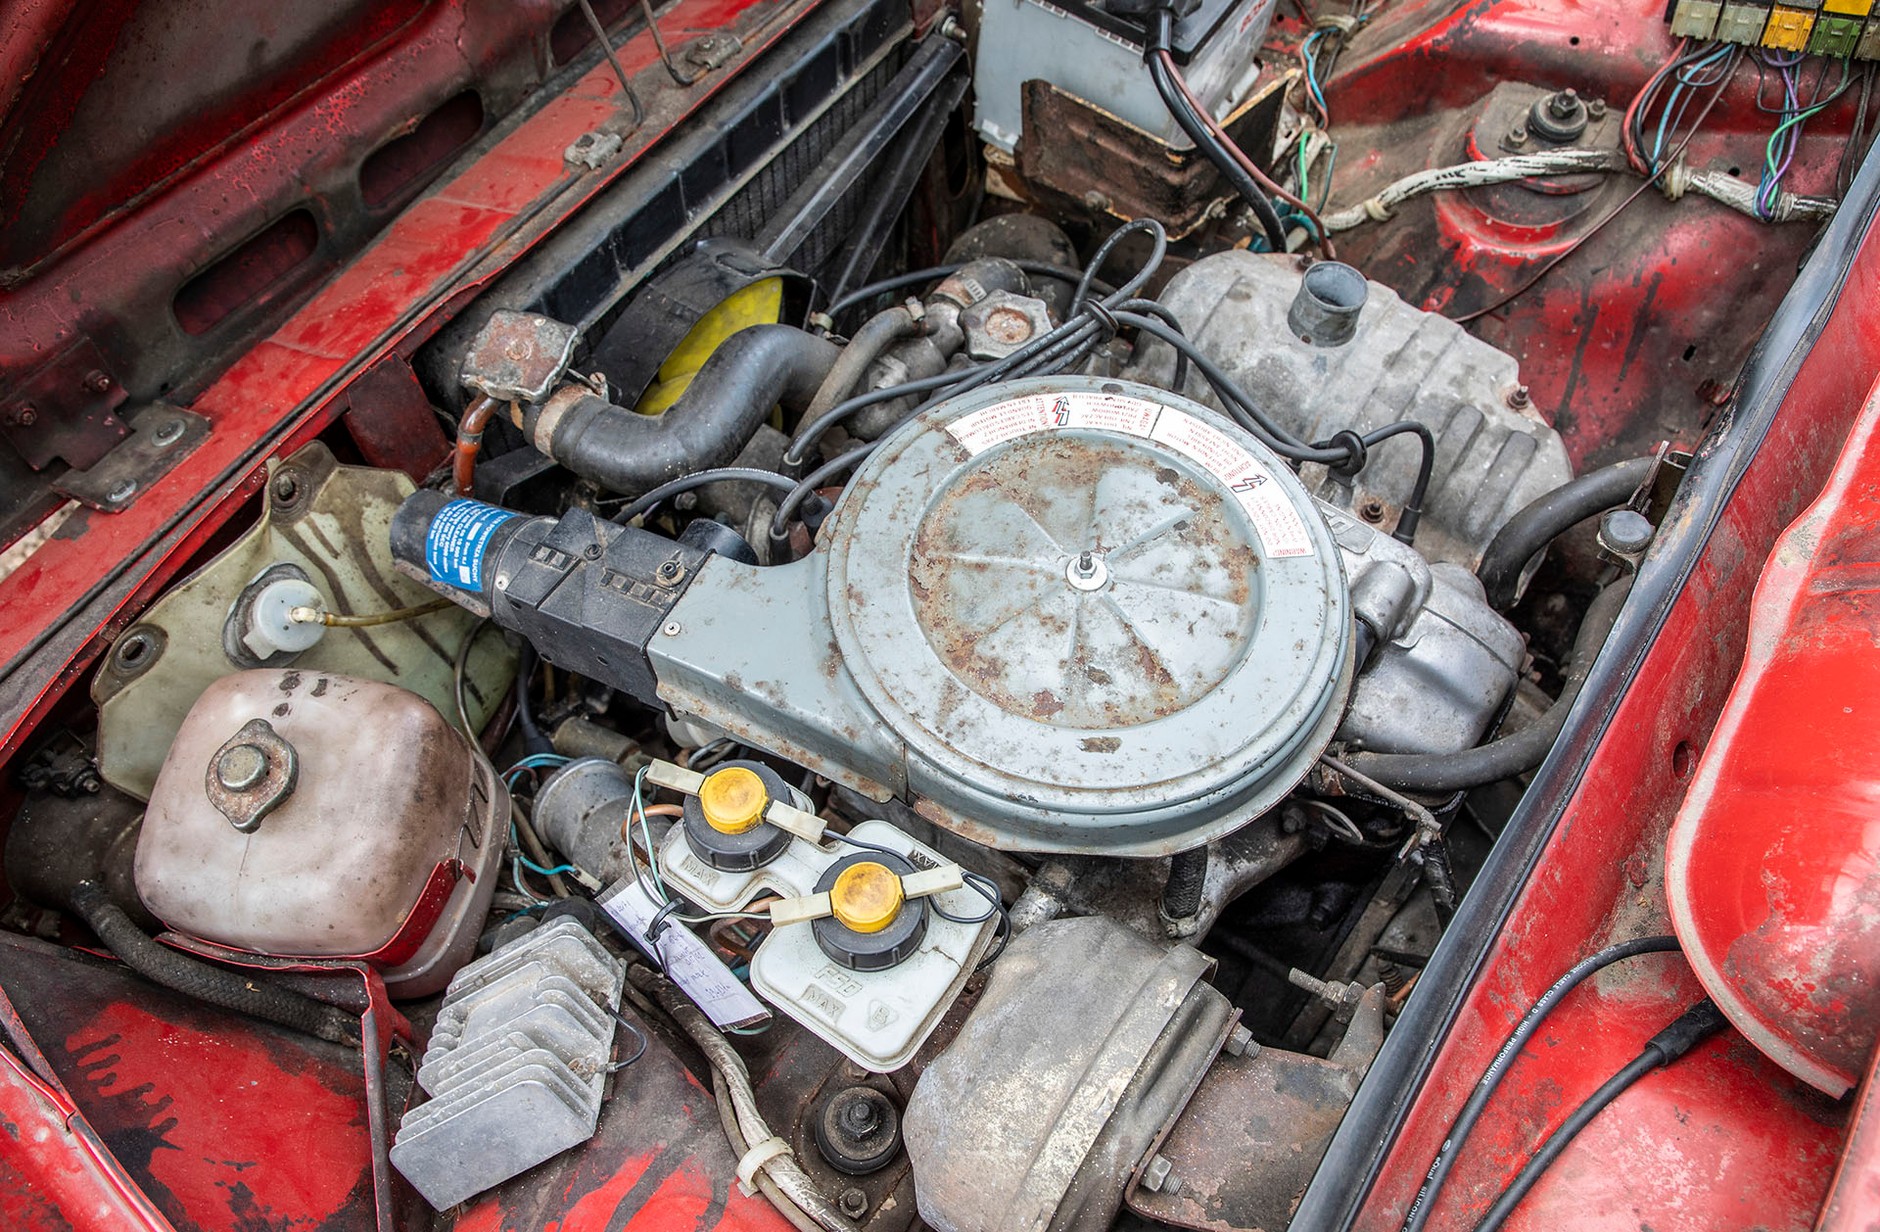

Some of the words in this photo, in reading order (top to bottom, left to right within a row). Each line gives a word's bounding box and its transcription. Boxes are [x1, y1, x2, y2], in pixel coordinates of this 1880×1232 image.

[1224, 460, 1252, 482] ACHTUNG!
[450, 523, 464, 552] CLEANER
[473, 523, 496, 558] POWIETRZA
[1272, 548, 1306, 556] WARNING!
[914, 850, 939, 869] AX
[684, 860, 716, 886] MAX
[1553, 974, 1570, 990] CABLE
[805, 989, 839, 1018] MAX
[1537, 990, 1554, 1007] CLASS
[1514, 1020, 1530, 1036] HIGH
[1482, 1038, 1516, 1085] PERFORMANCE
[1407, 1186, 1427, 1222] SILICONE
